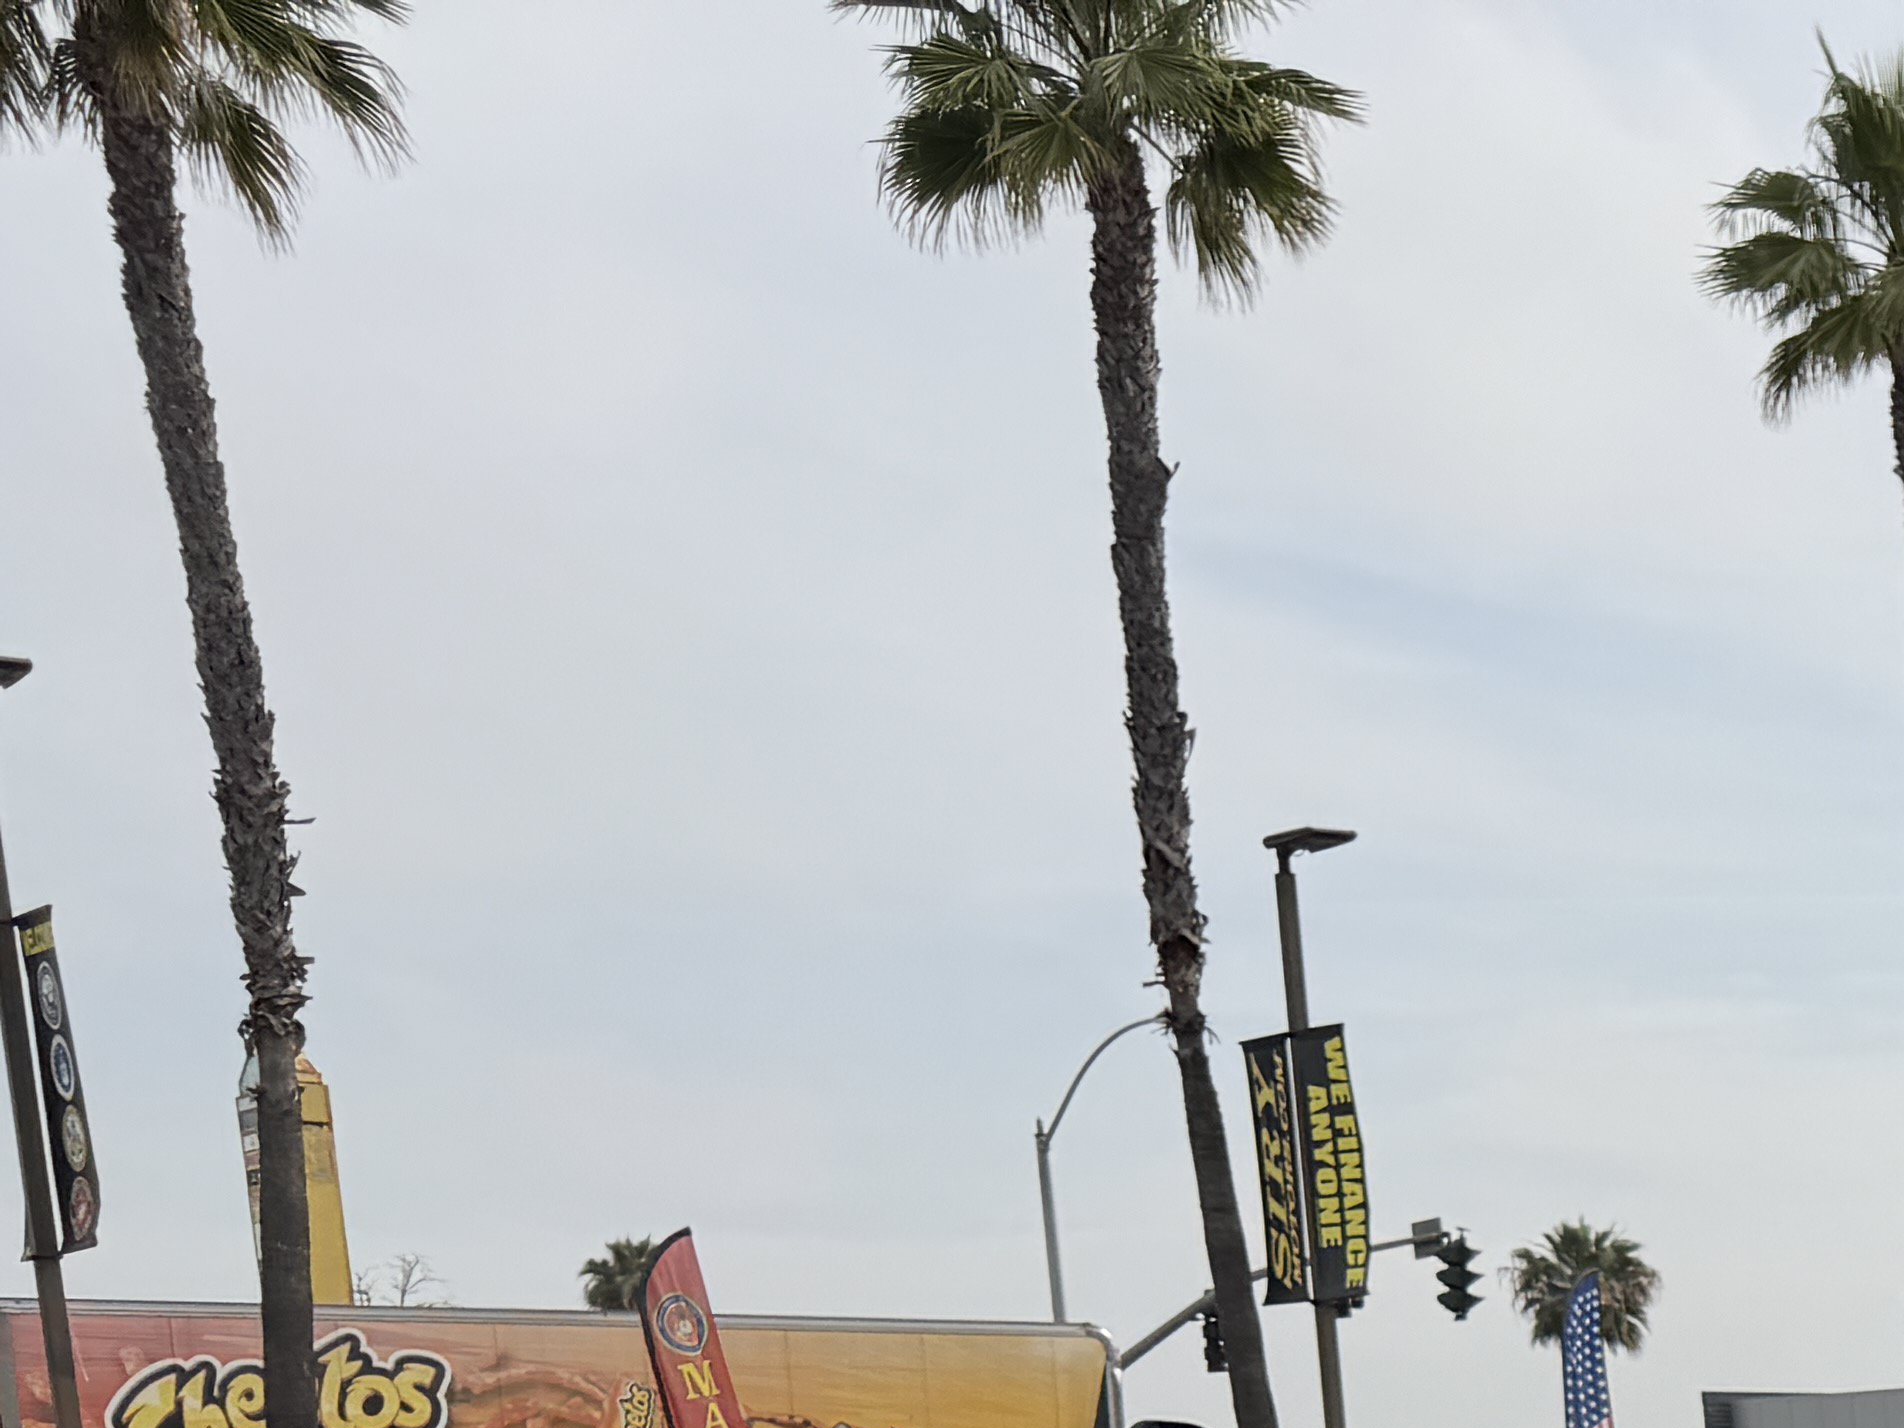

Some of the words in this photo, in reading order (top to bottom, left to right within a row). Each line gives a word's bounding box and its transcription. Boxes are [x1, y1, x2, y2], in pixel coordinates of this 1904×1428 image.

[1324, 1035, 1351, 1105] WE
[1249, 1052, 1293, 1290] SIRY
[1306, 1084, 1343, 1249] ANYONE
[1334, 1114, 1368, 1290] FINANCE
